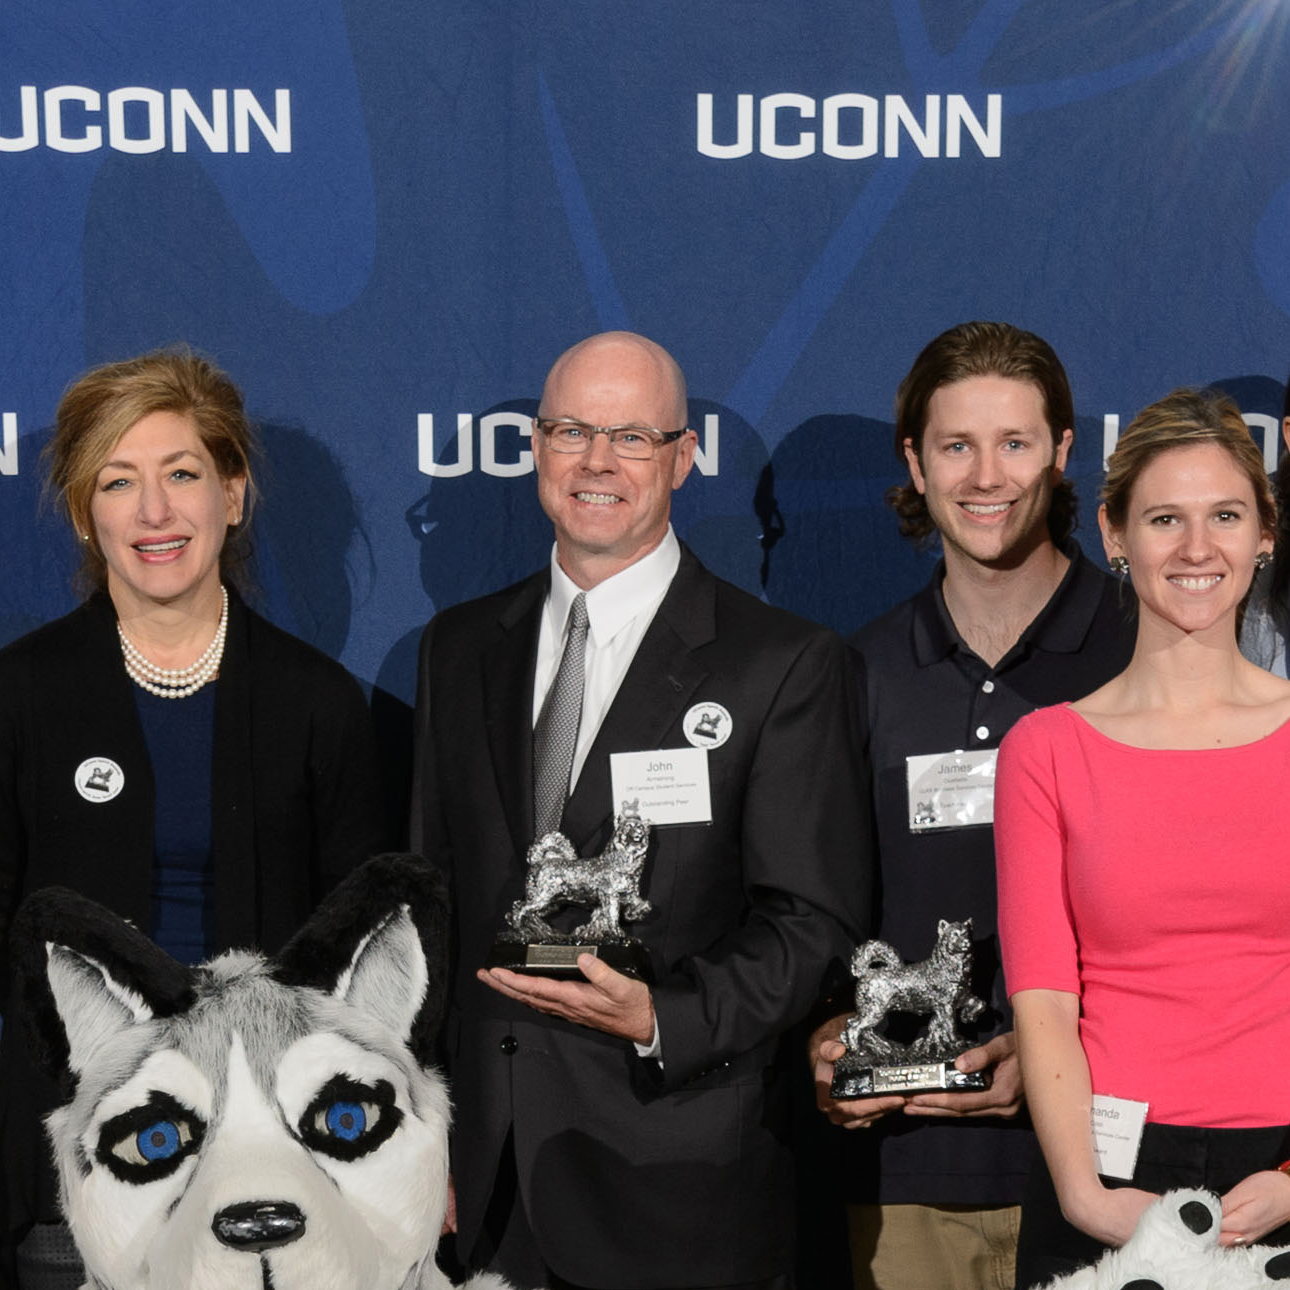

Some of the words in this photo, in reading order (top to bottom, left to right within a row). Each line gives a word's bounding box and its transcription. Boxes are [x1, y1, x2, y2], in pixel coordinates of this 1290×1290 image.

[698, 93, 1001, 160] UCONN
[647, 762, 673, 772] John
[938, 764, 972, 775] James
